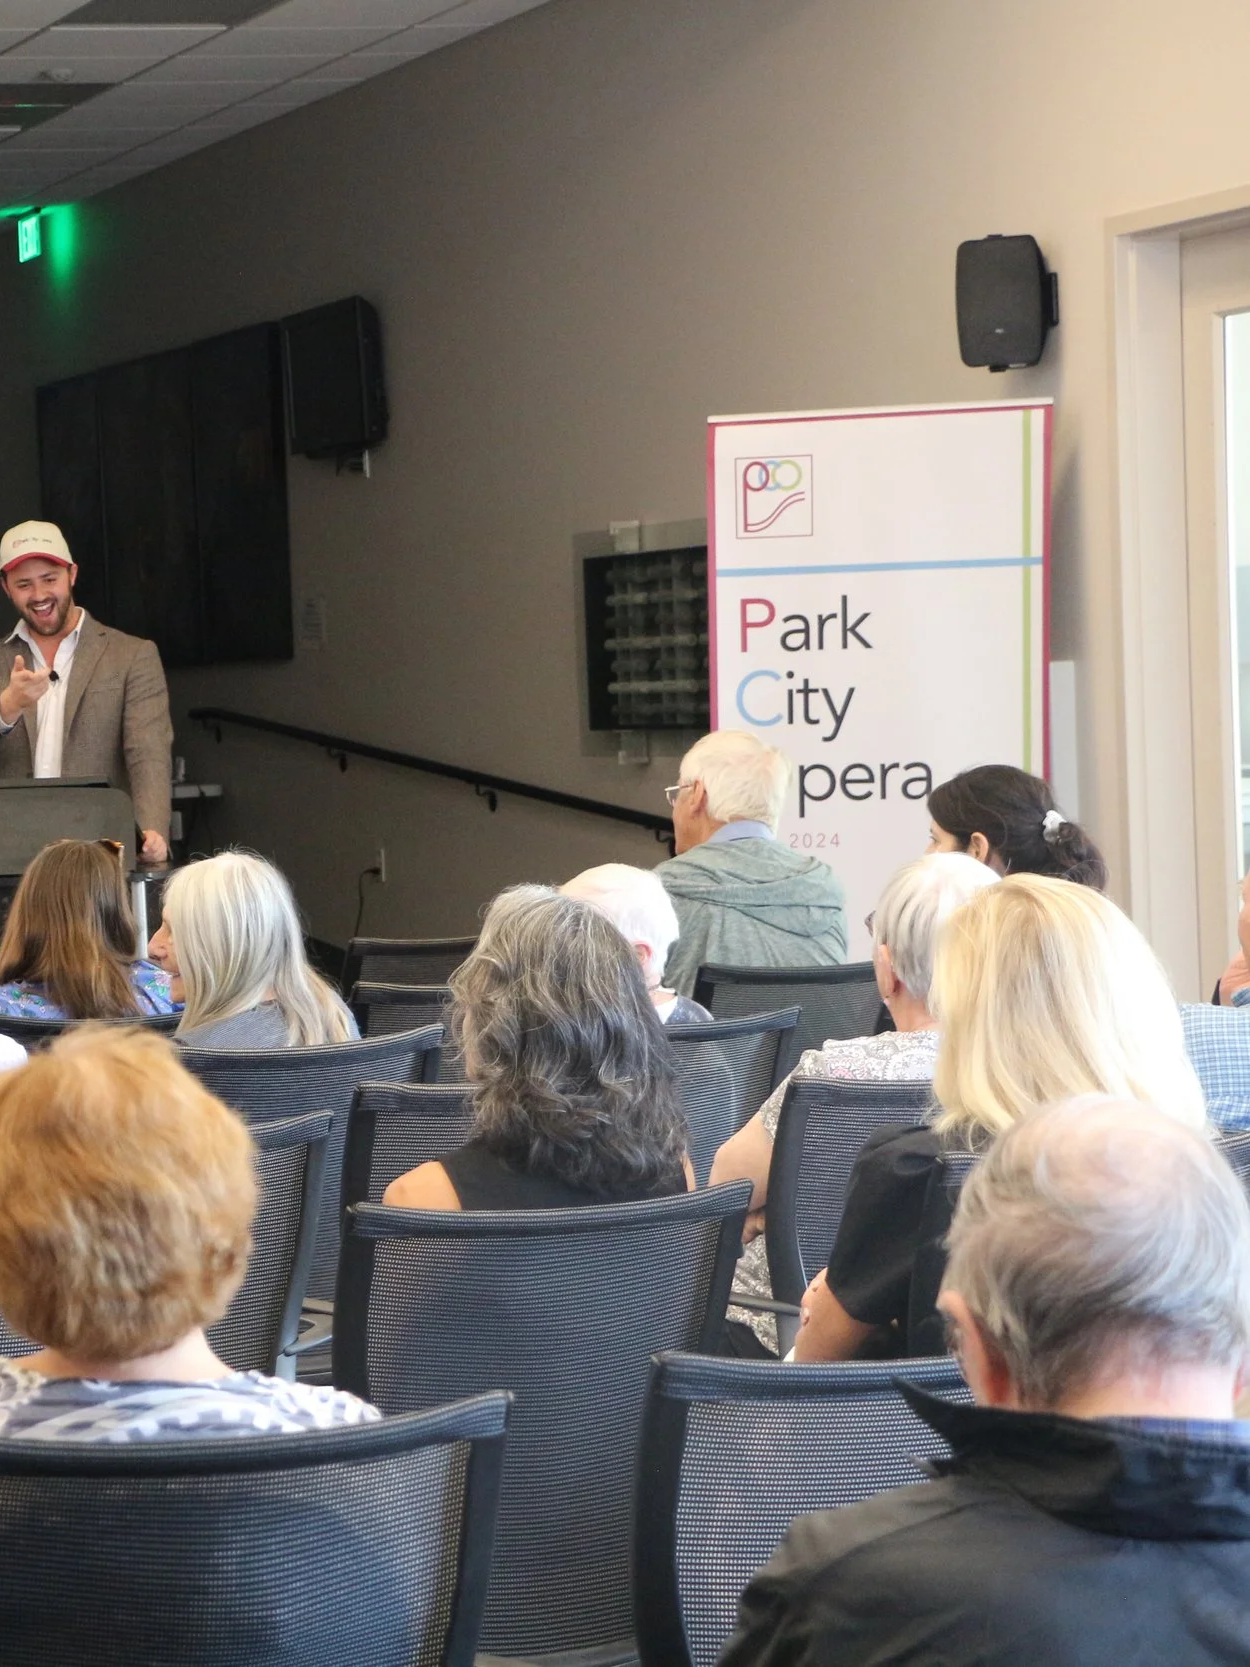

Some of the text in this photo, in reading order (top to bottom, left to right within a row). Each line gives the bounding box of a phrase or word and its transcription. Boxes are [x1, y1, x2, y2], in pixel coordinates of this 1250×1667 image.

[740, 594, 873, 653] Park
[736, 669, 855, 742] City
[798, 761, 932, 818] pera
[789, 832, 841, 849] 2024
